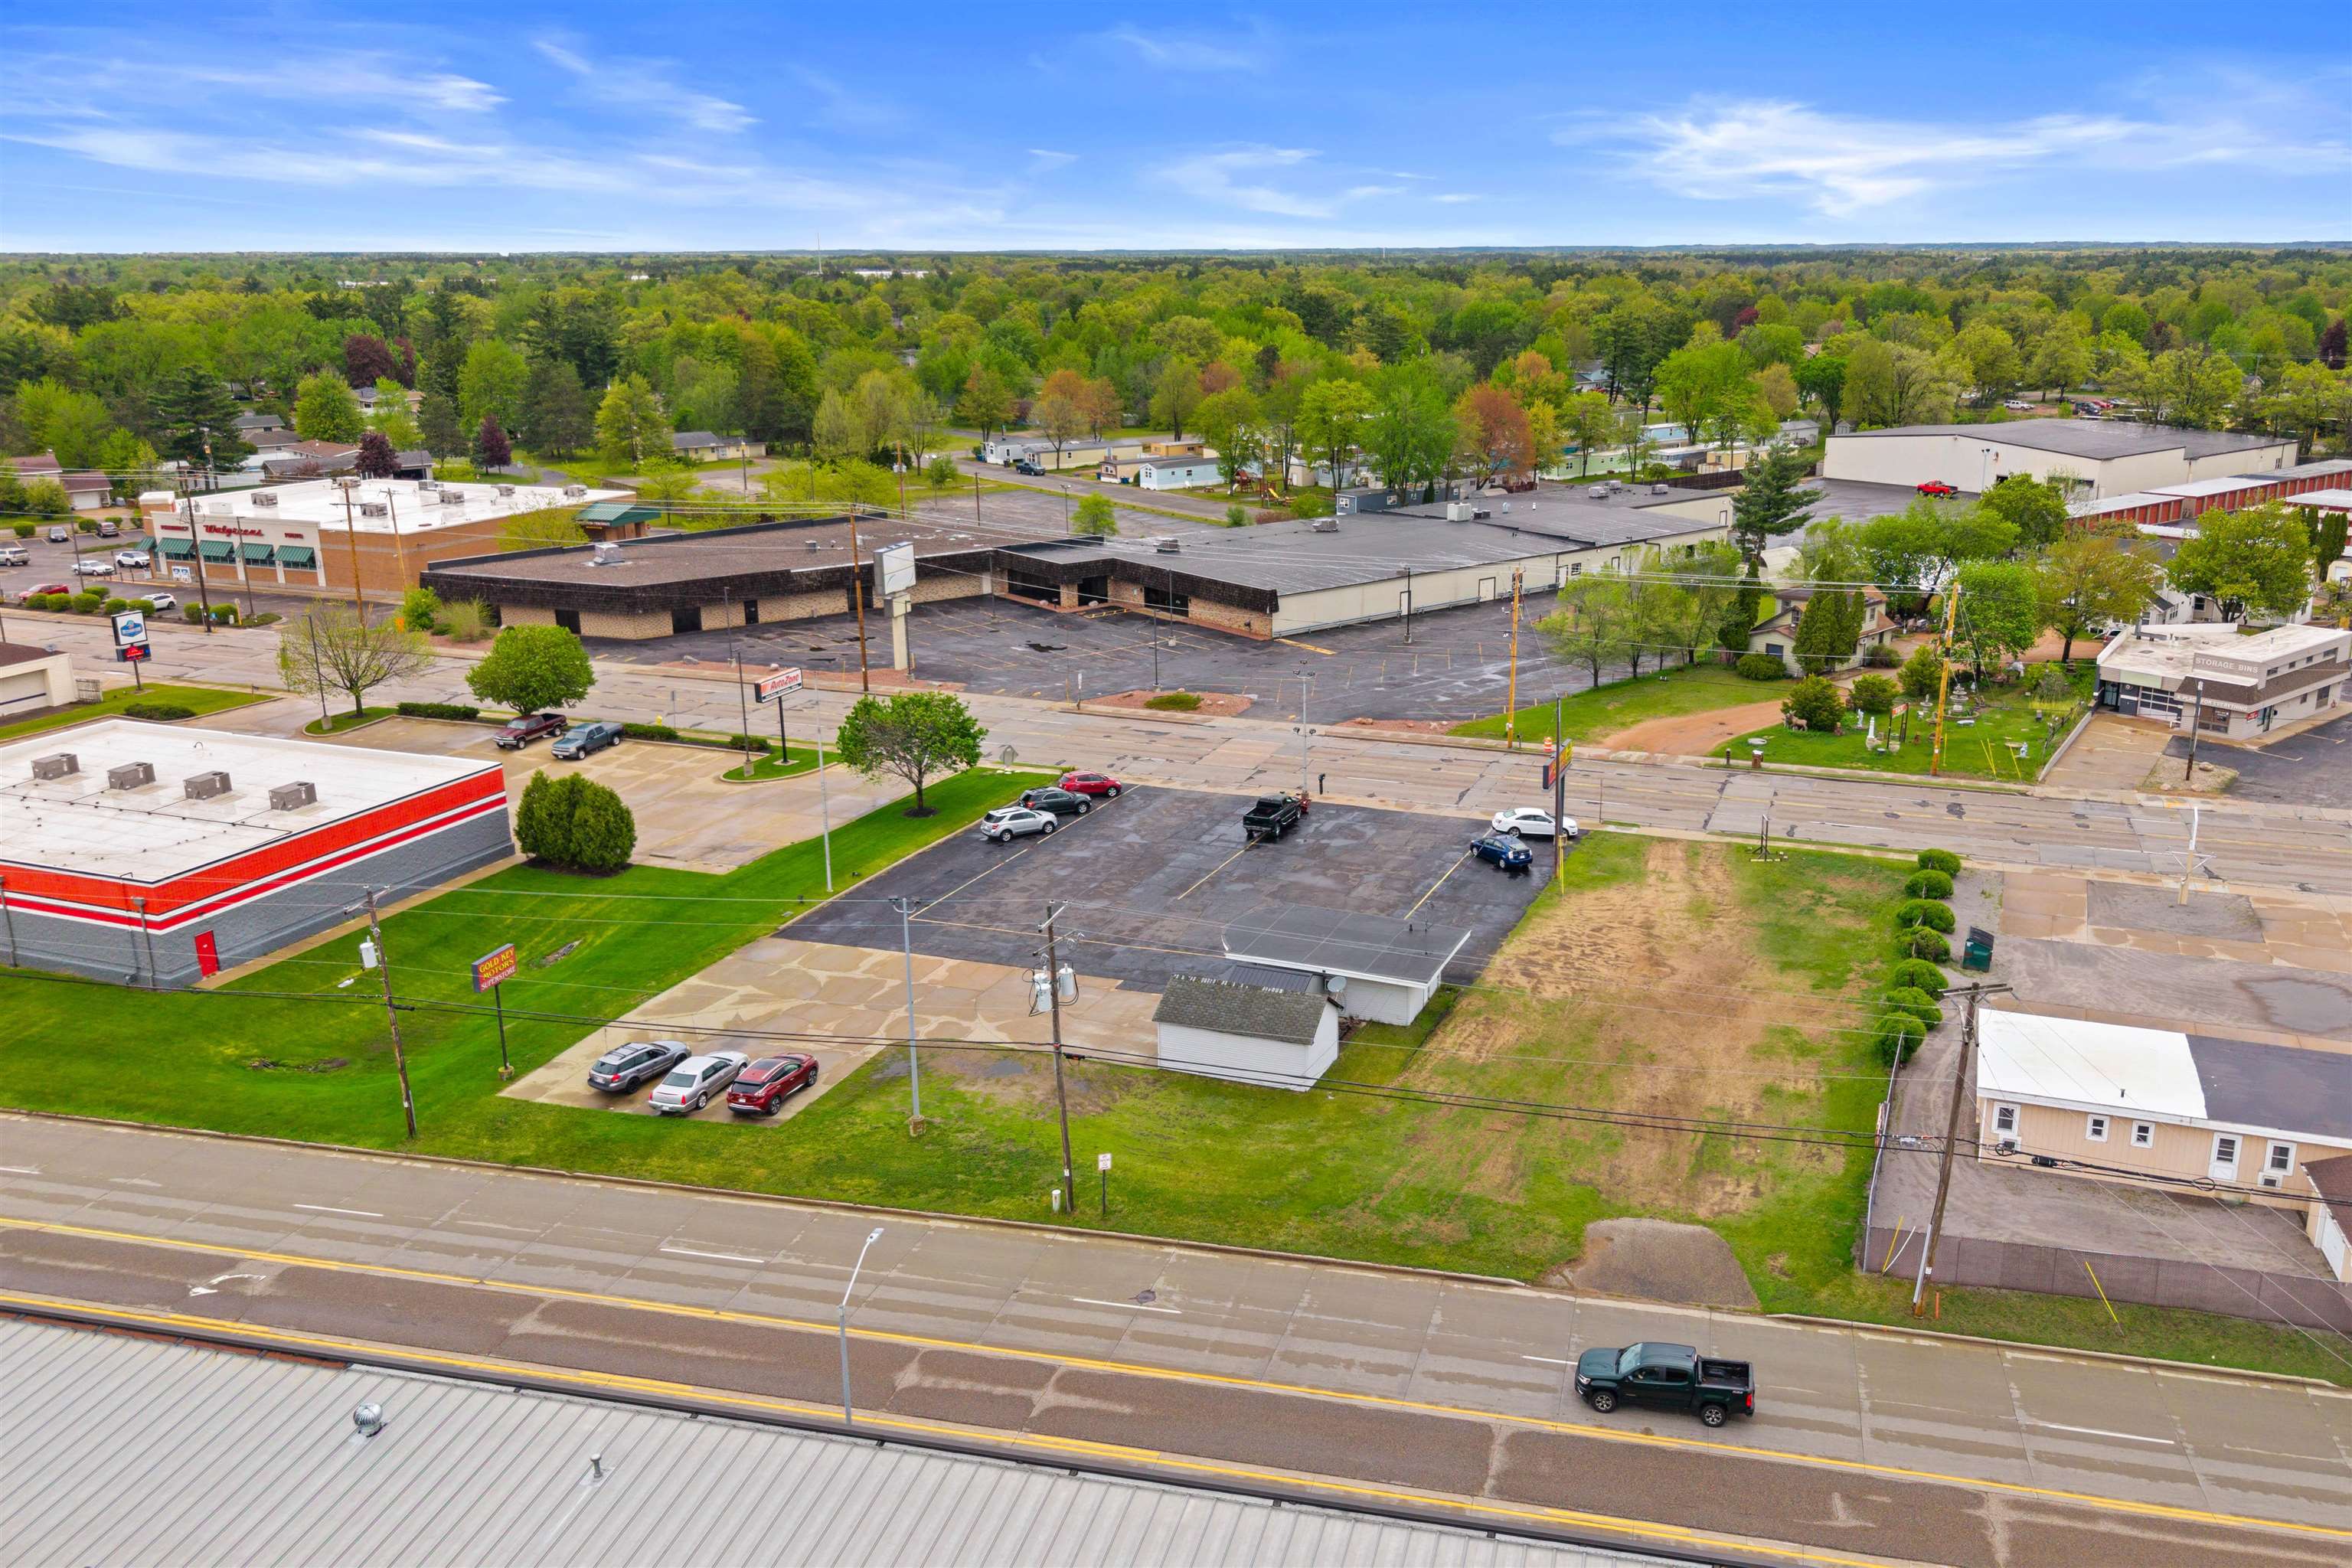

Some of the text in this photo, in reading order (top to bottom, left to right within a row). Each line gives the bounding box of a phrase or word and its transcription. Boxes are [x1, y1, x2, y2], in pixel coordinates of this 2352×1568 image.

[203, 524, 264, 537] Walgreens
[2195, 657, 2259, 674] STORAGE BINS
[479, 949, 514, 973] GOLD KEY
[483, 960, 514, 978] MOTORS
[481, 965, 516, 991] SUPERSTORE
